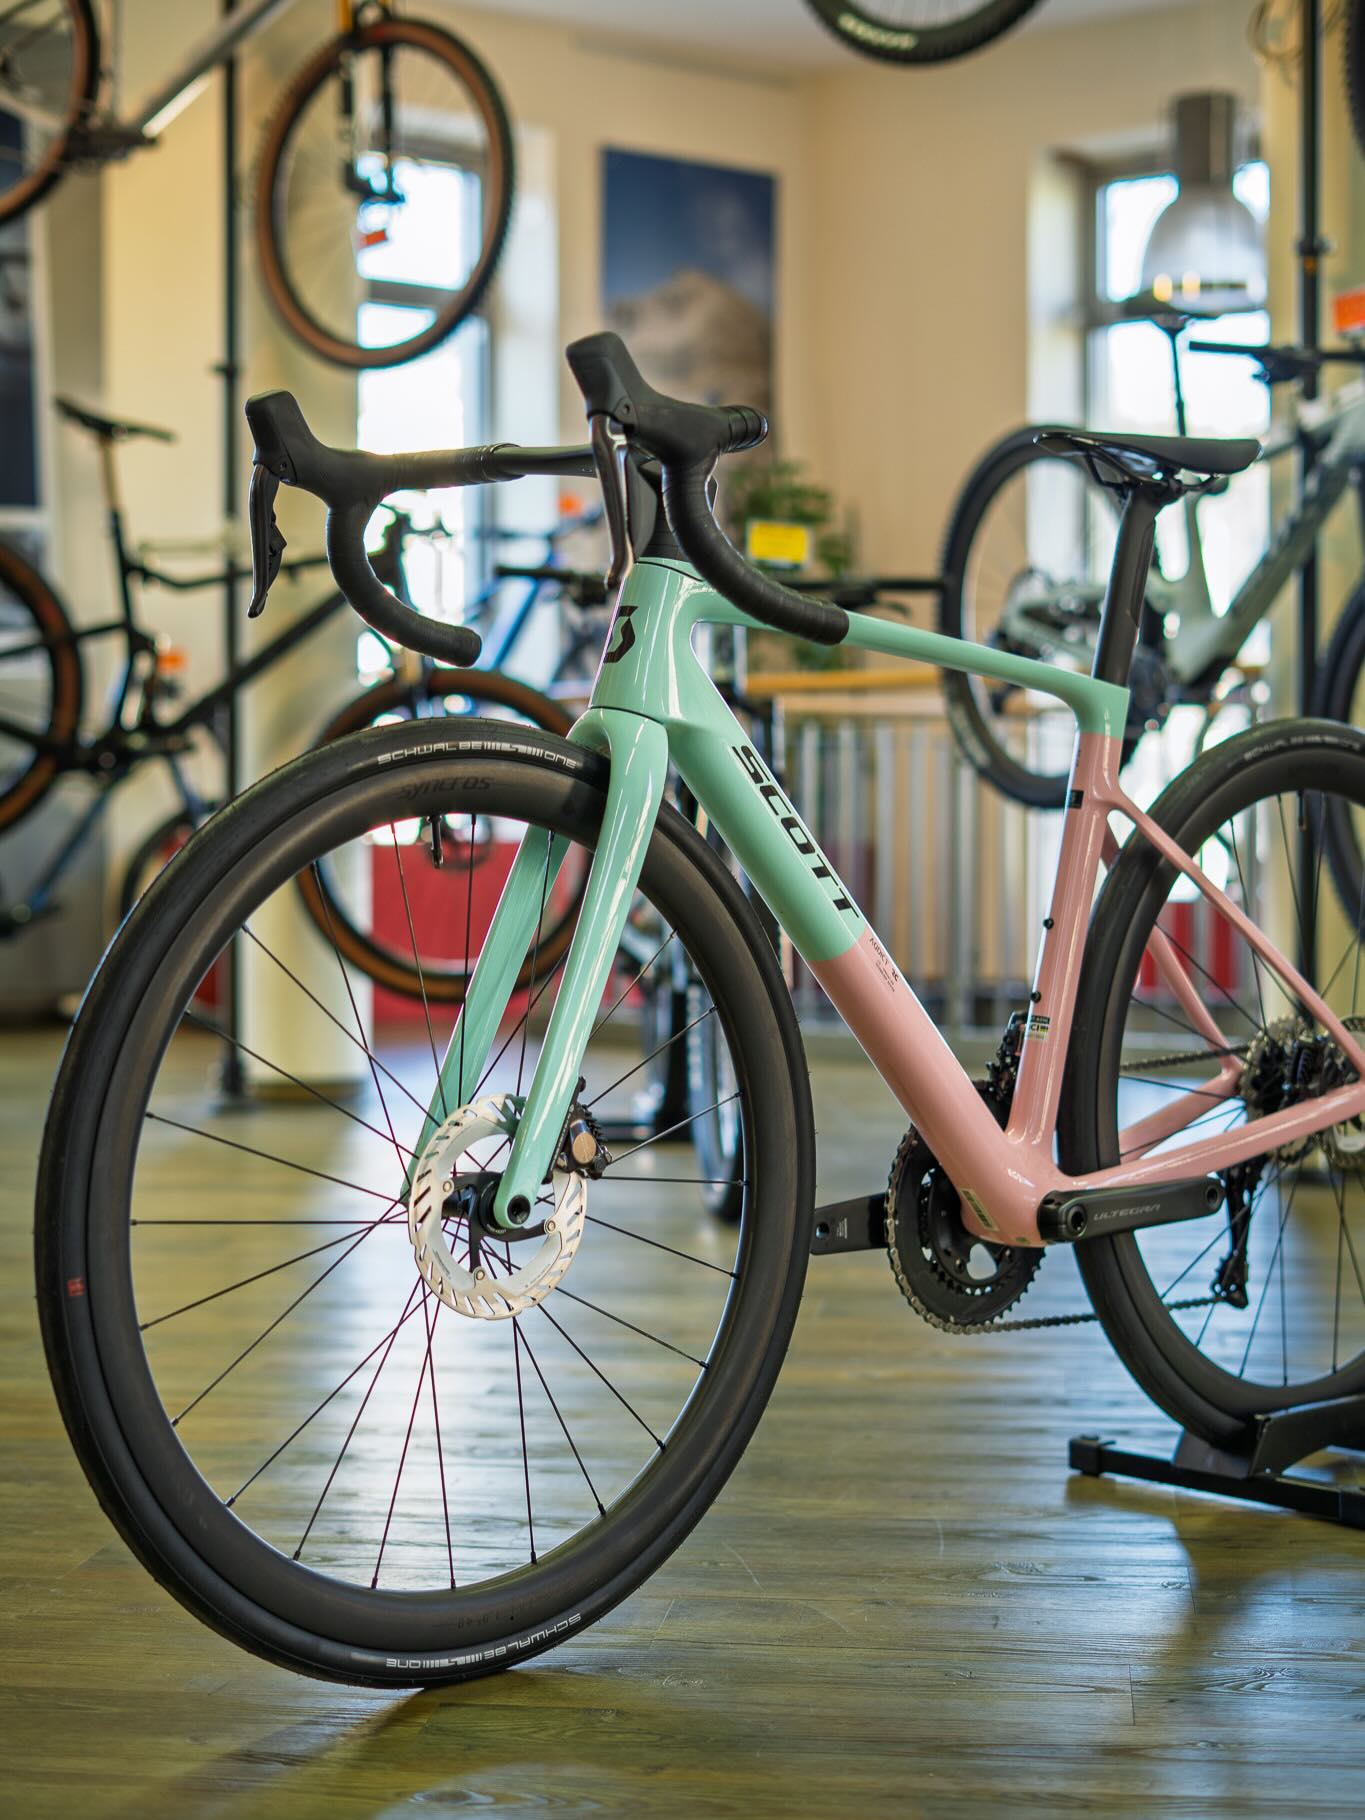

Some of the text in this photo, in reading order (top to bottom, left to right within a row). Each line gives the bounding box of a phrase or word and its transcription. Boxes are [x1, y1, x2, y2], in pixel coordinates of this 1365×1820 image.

[377, 741, 577, 770] SCHWALBE ONE
[732, 745, 860, 918] SCOTT
[484, 1612, 582, 1660] SCHWALBE
[386, 1658, 421, 1669] ONE
